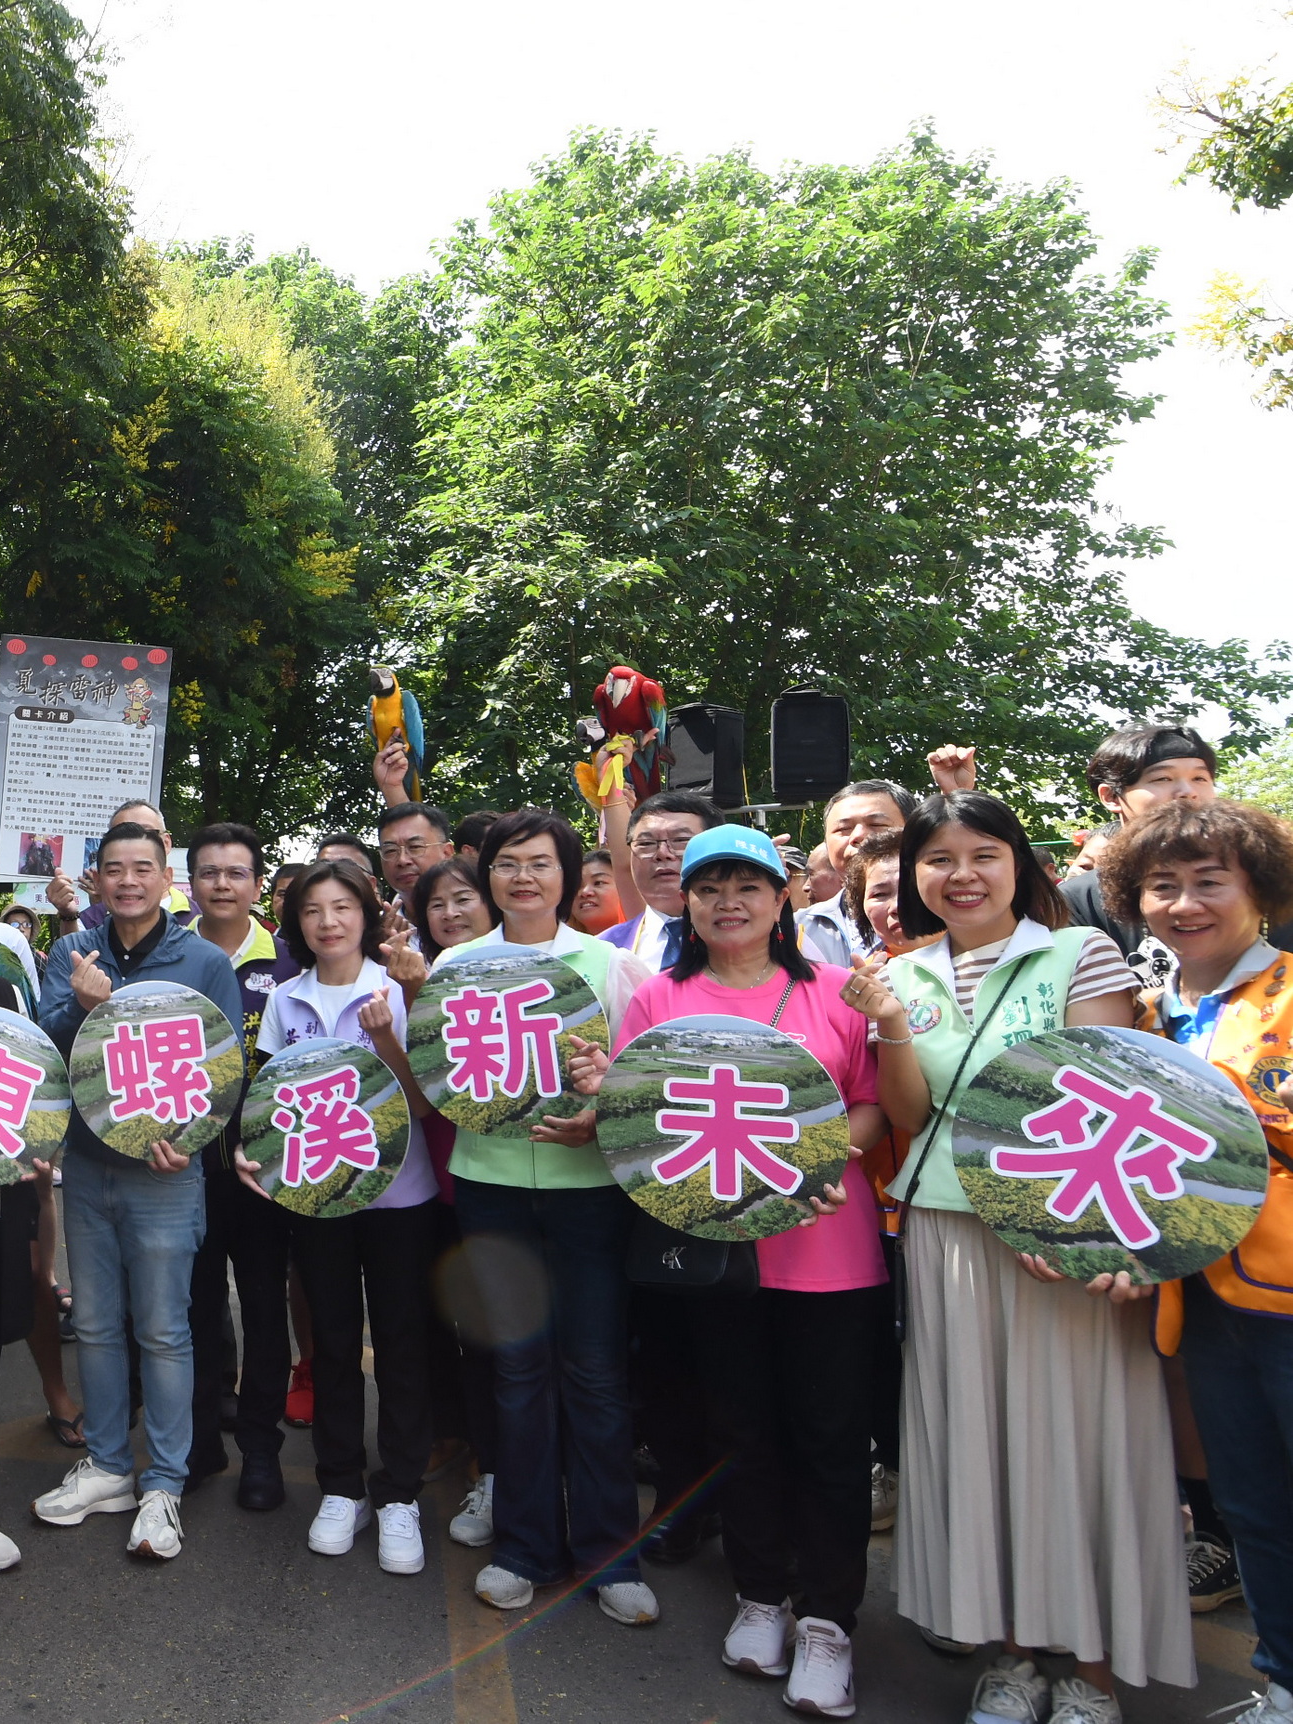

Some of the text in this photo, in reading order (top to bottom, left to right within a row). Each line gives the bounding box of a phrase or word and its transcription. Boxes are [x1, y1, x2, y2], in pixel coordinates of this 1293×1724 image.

[21, 708, 70, 722] 關卡介紹
[104, 1015, 211, 1122] 螺
[443, 980, 561, 1101] 新
[275, 1066, 378, 1186] 溪
[654, 1065, 801, 1199] 未
[994, 1068, 1213, 1246] 來
